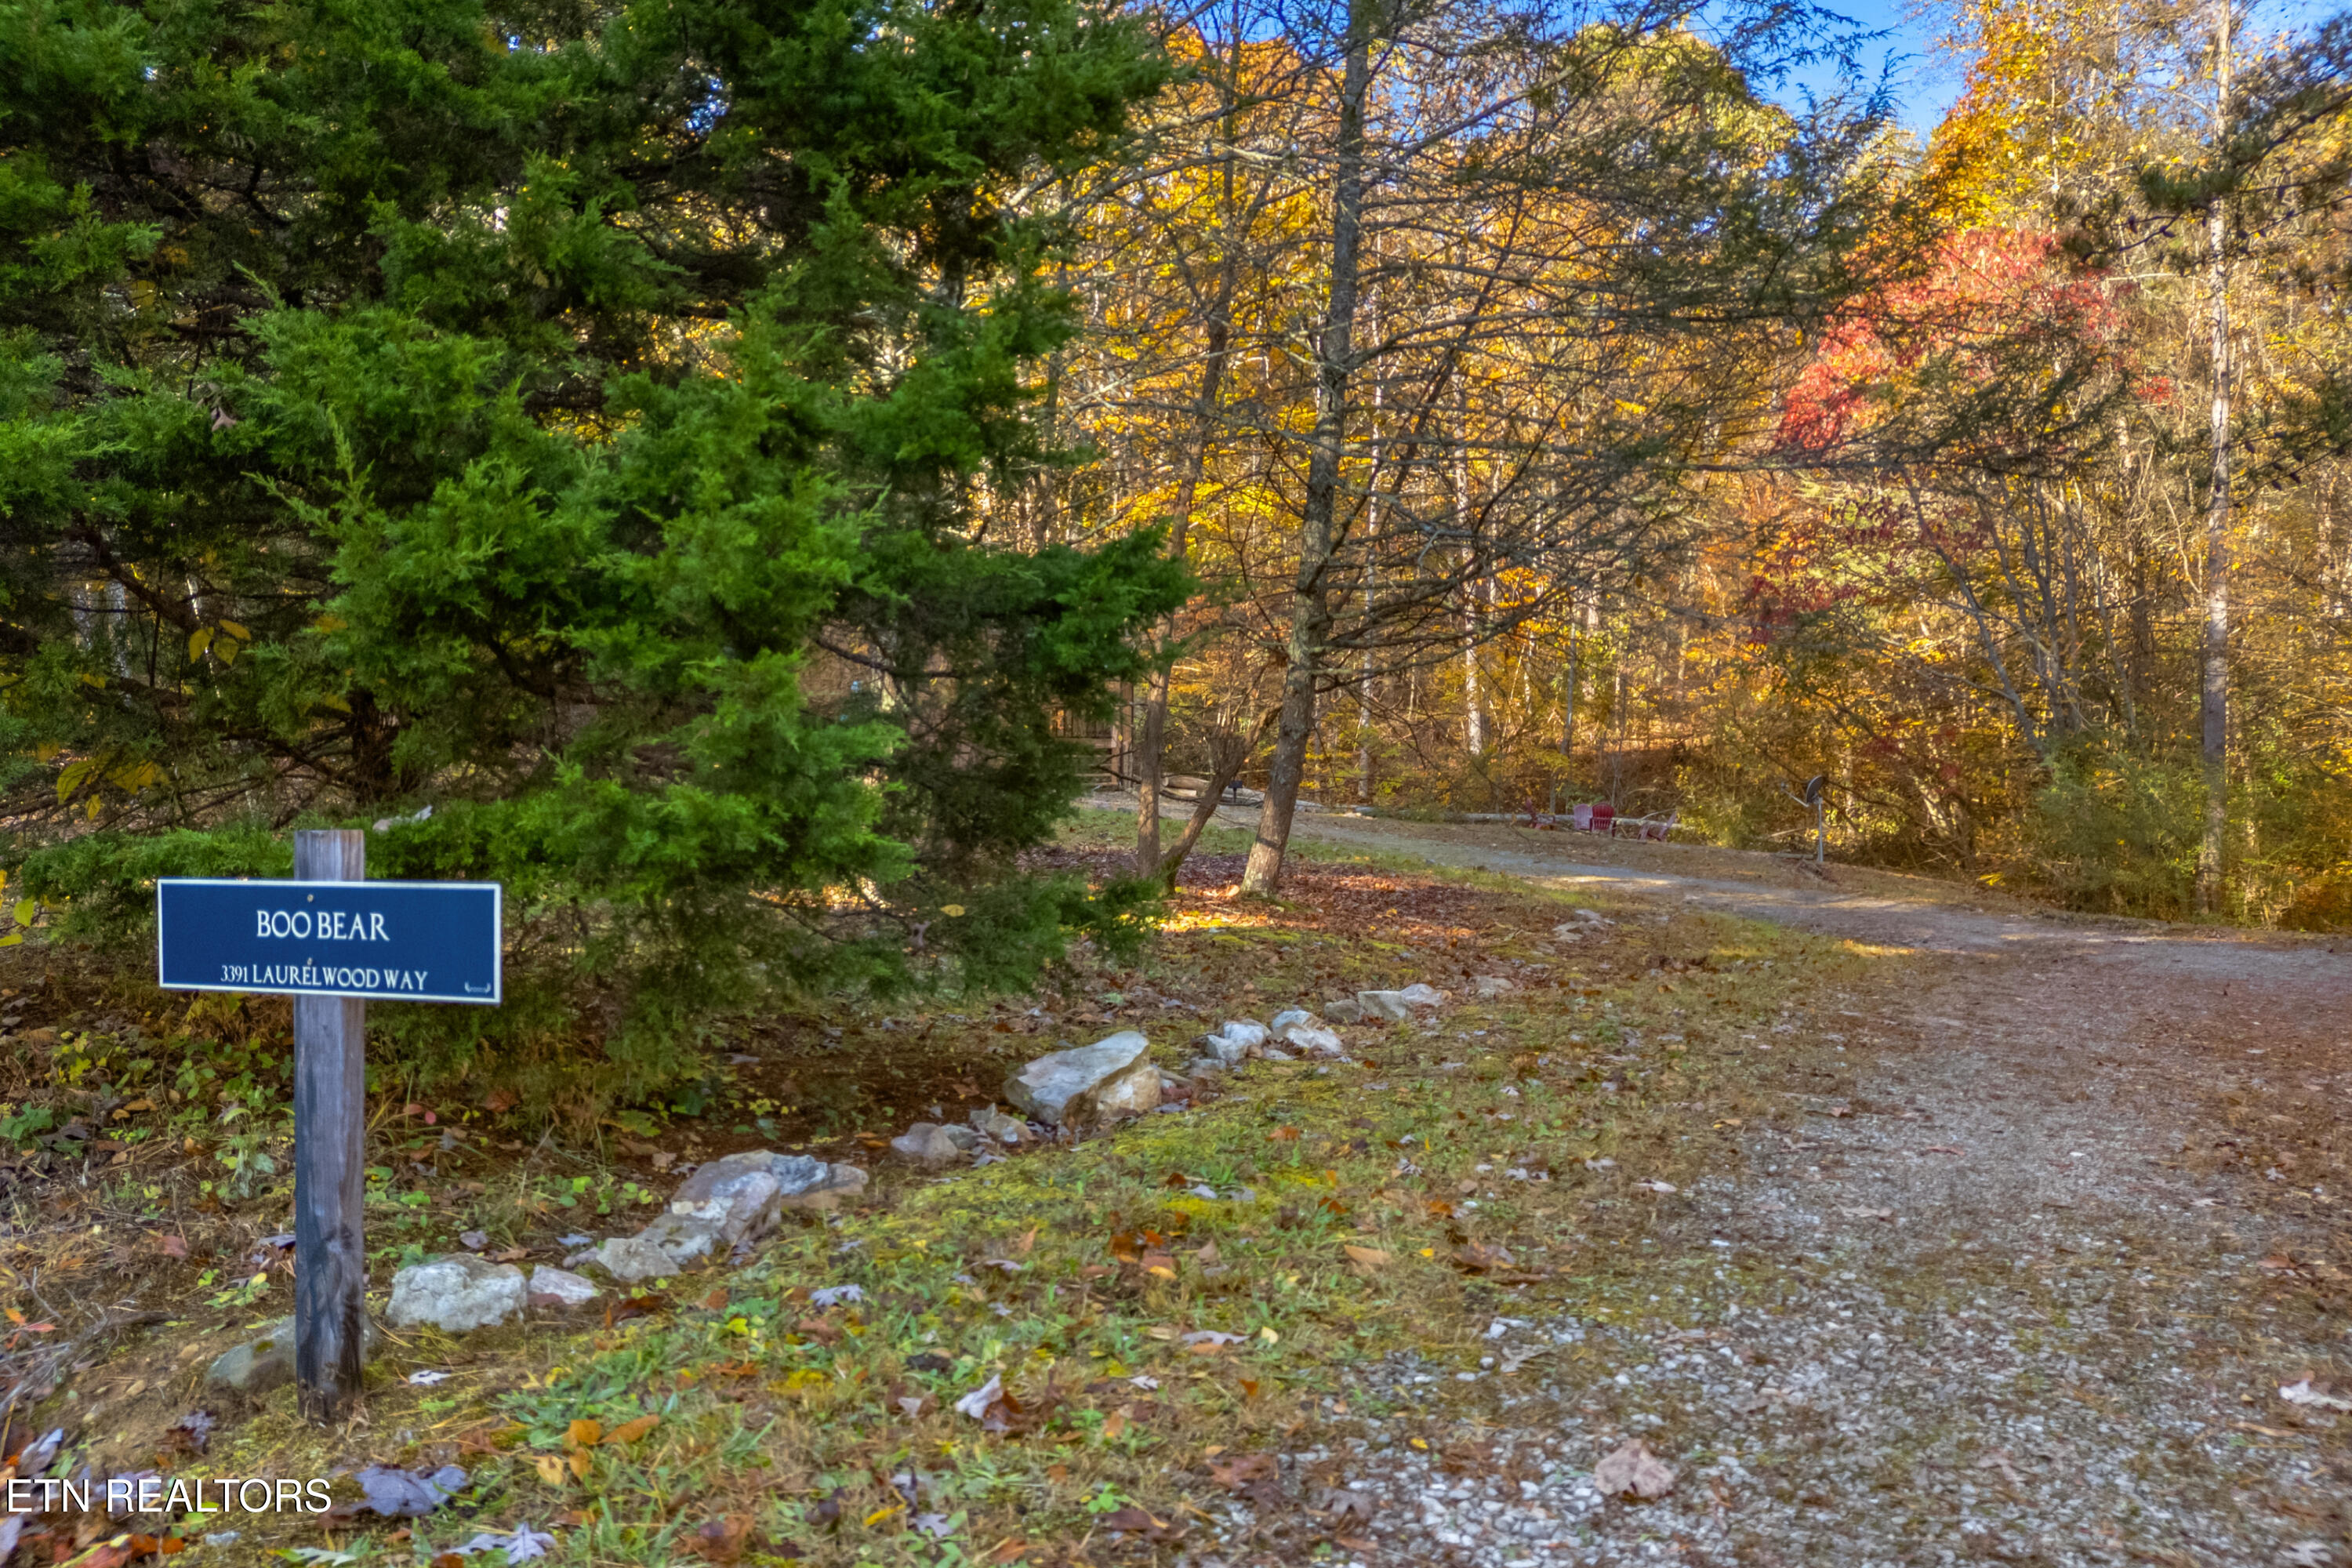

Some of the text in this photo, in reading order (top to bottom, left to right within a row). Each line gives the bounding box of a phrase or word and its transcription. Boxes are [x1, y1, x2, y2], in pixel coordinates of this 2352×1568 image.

[256, 909, 390, 942] BOO BEAR
[220, 964, 428, 991] 3391 LAURELWOOD WAY
